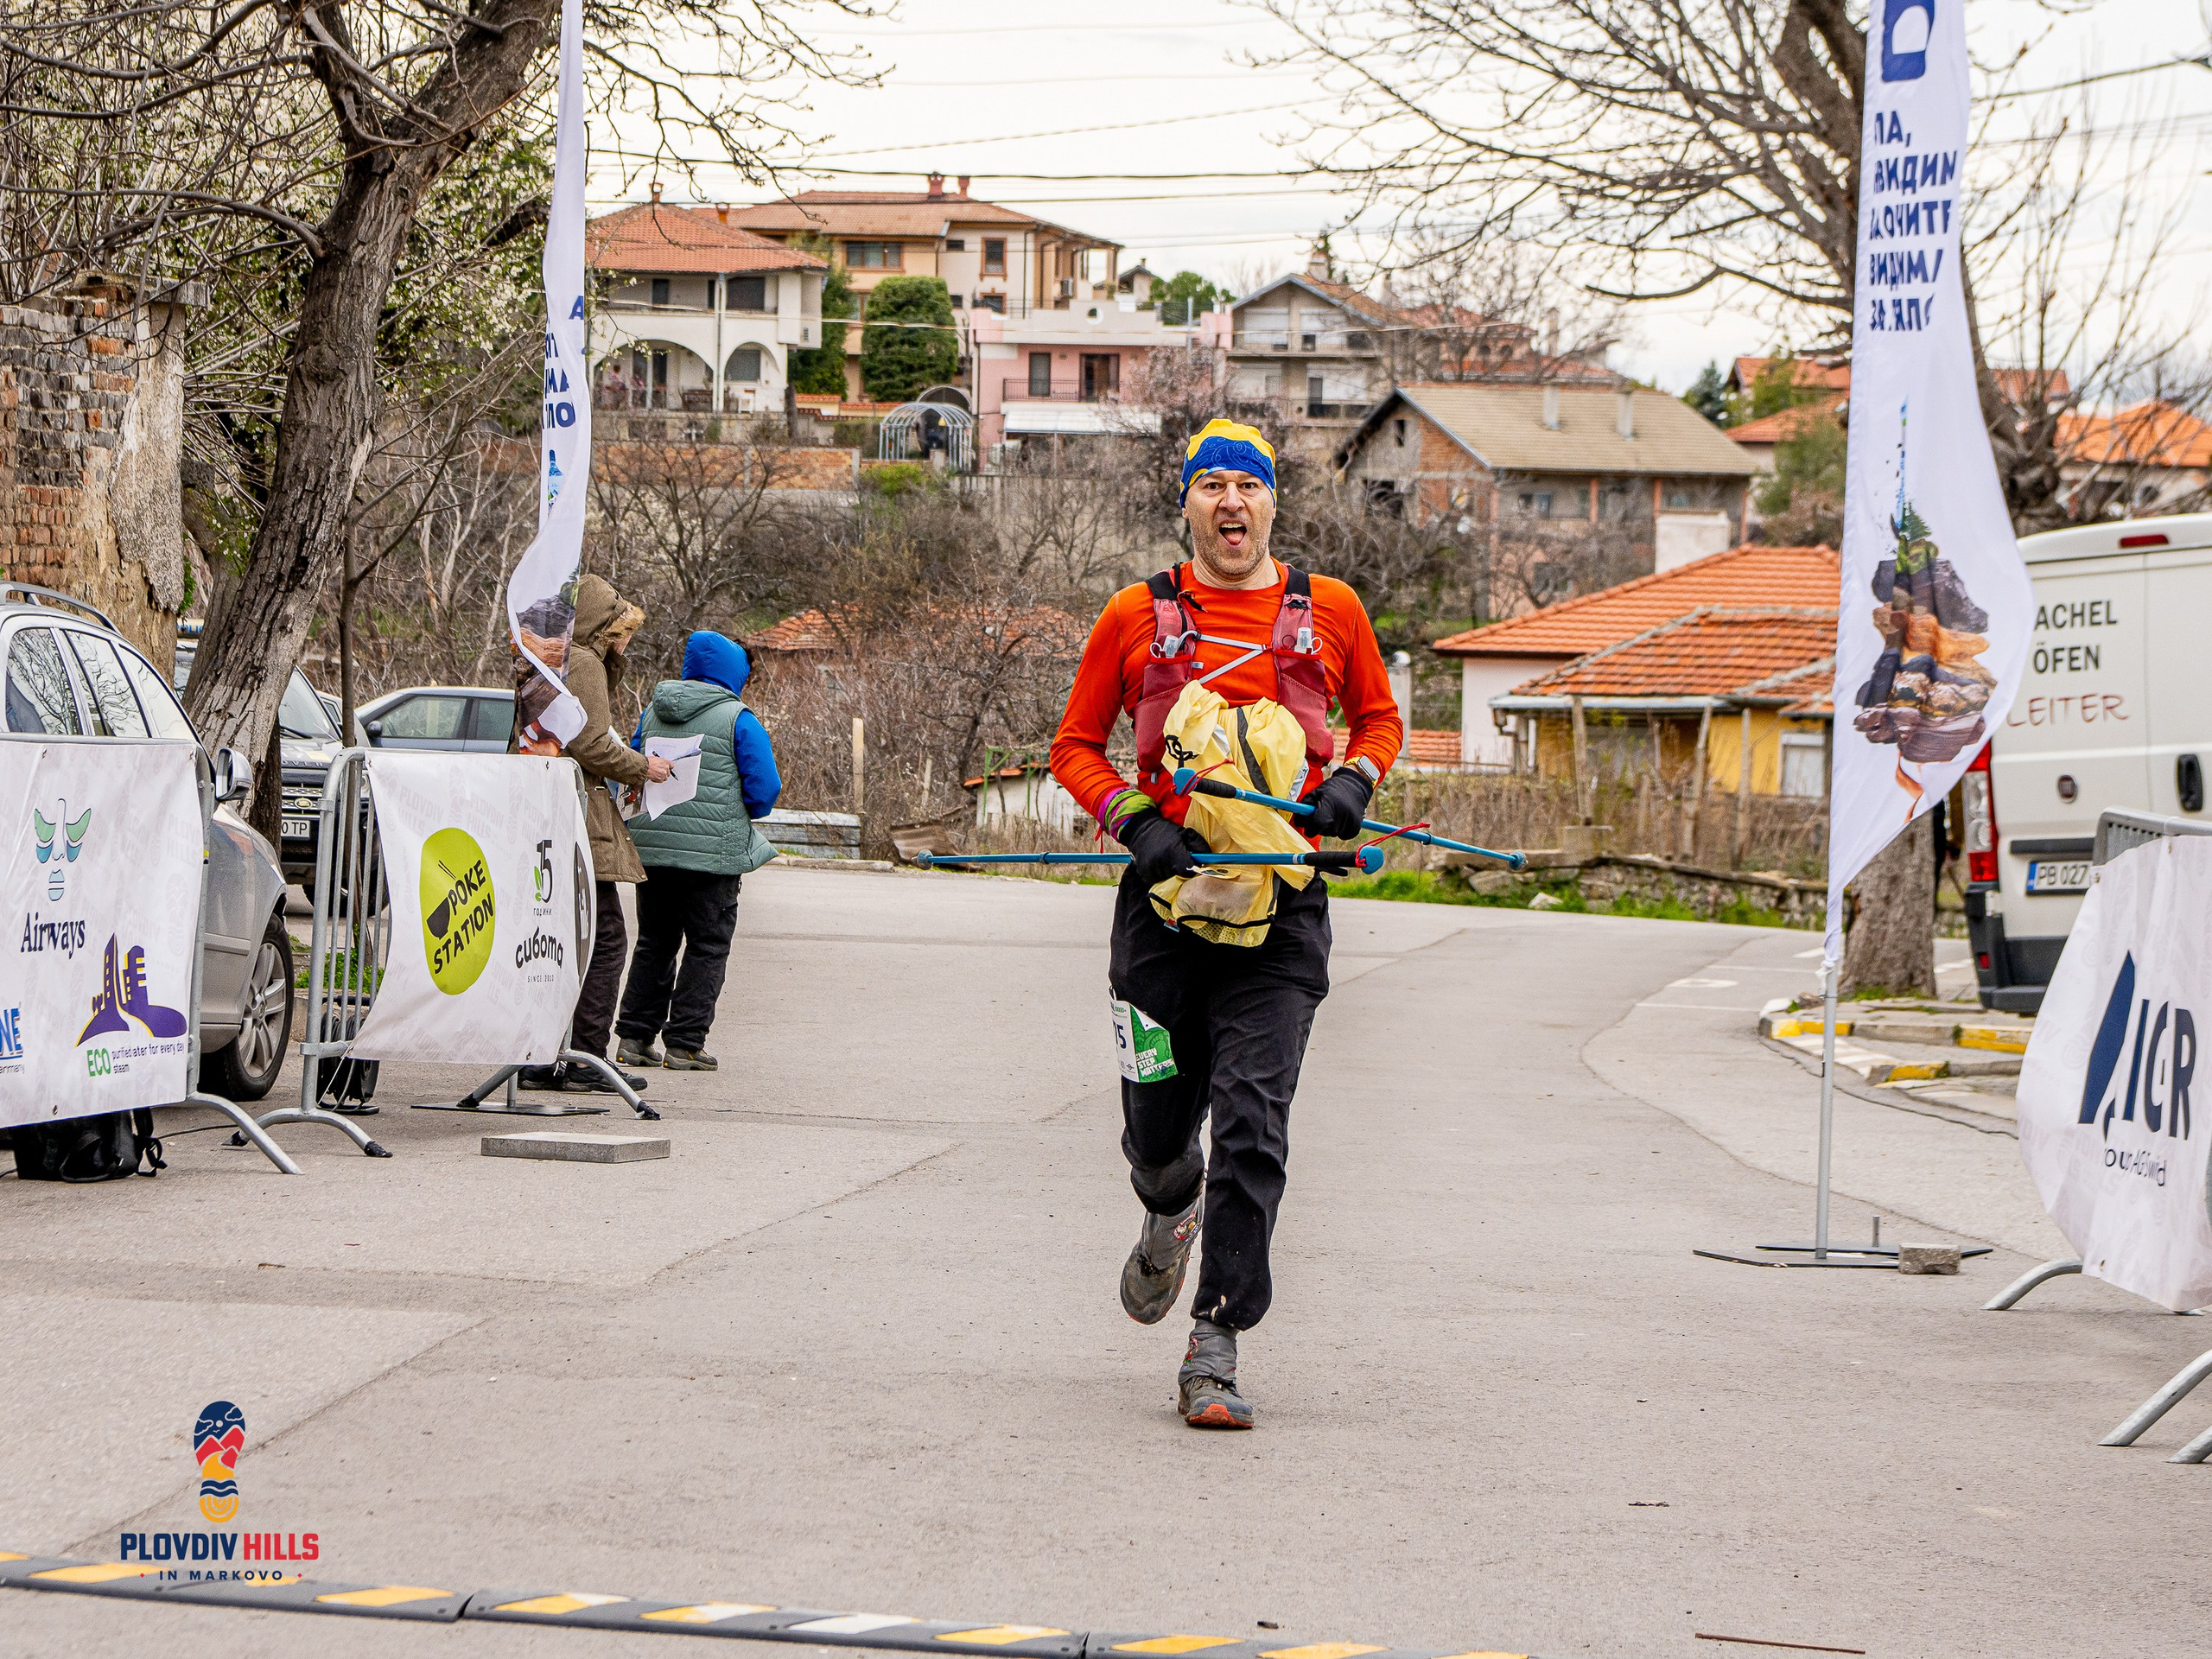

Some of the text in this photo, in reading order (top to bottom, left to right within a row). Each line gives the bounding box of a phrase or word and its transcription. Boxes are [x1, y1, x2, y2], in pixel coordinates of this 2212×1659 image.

[1874, 150, 1957, 195] ВИДИМ
[2034, 600, 2119, 632] ACHEL
[2033, 642, 2101, 674] ÖFEN
[2005, 692, 2129, 728] LEITER
[292, 823, 308, 836] TP
[448, 860, 487, 915] POKE
[2060, 864, 2088, 885] 027
[21, 912, 85, 959] Airways
[433, 896, 494, 975] STATION
[0, 1008, 22, 1055] NE
[86, 1048, 111, 1077] ECO
[133, 1045, 148, 1057] ater
[149, 1043, 159, 1055] for
